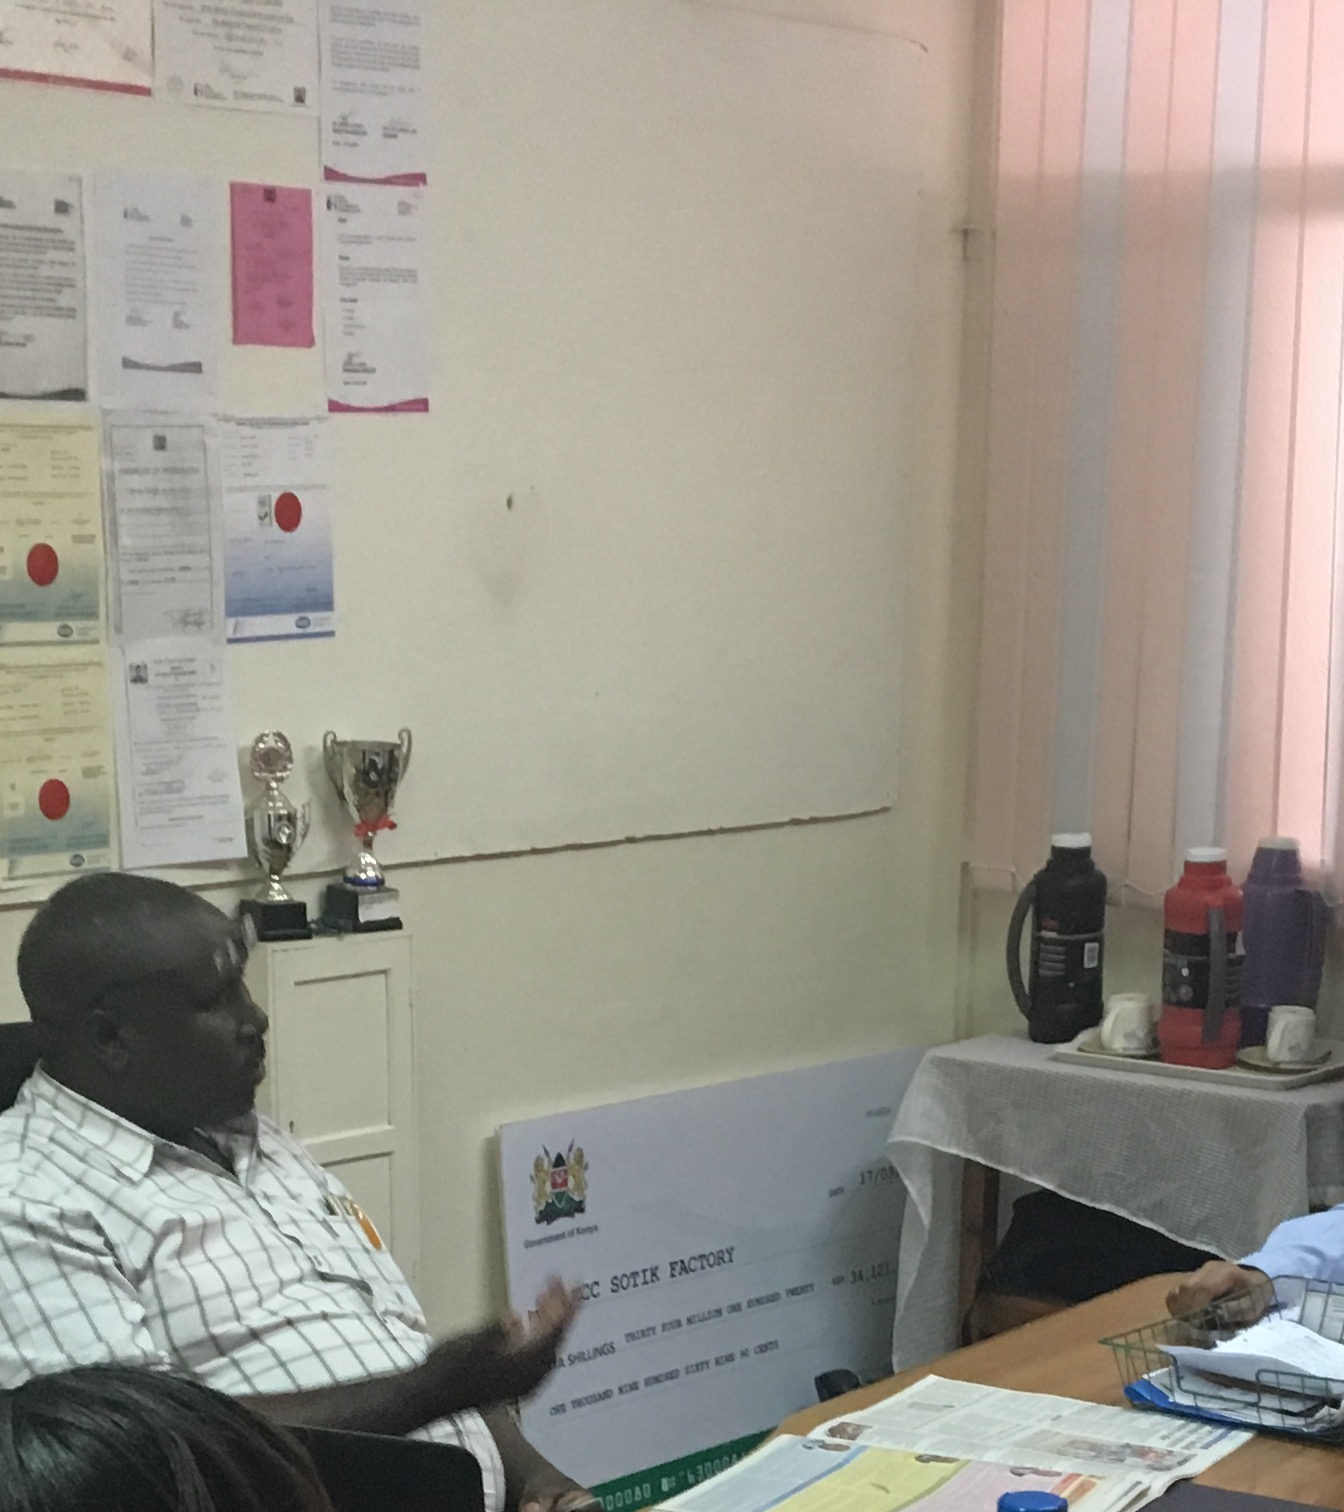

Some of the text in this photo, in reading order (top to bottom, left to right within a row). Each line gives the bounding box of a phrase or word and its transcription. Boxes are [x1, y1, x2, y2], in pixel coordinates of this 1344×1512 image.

[610, 1266, 661, 1293] SOTIK
[669, 1246, 735, 1279] FACTORY
[567, 1341, 616, 1366] SHILLINGS
[624, 1326, 657, 1344] THIRTY
[687, 1307, 723, 1326] MILLION
